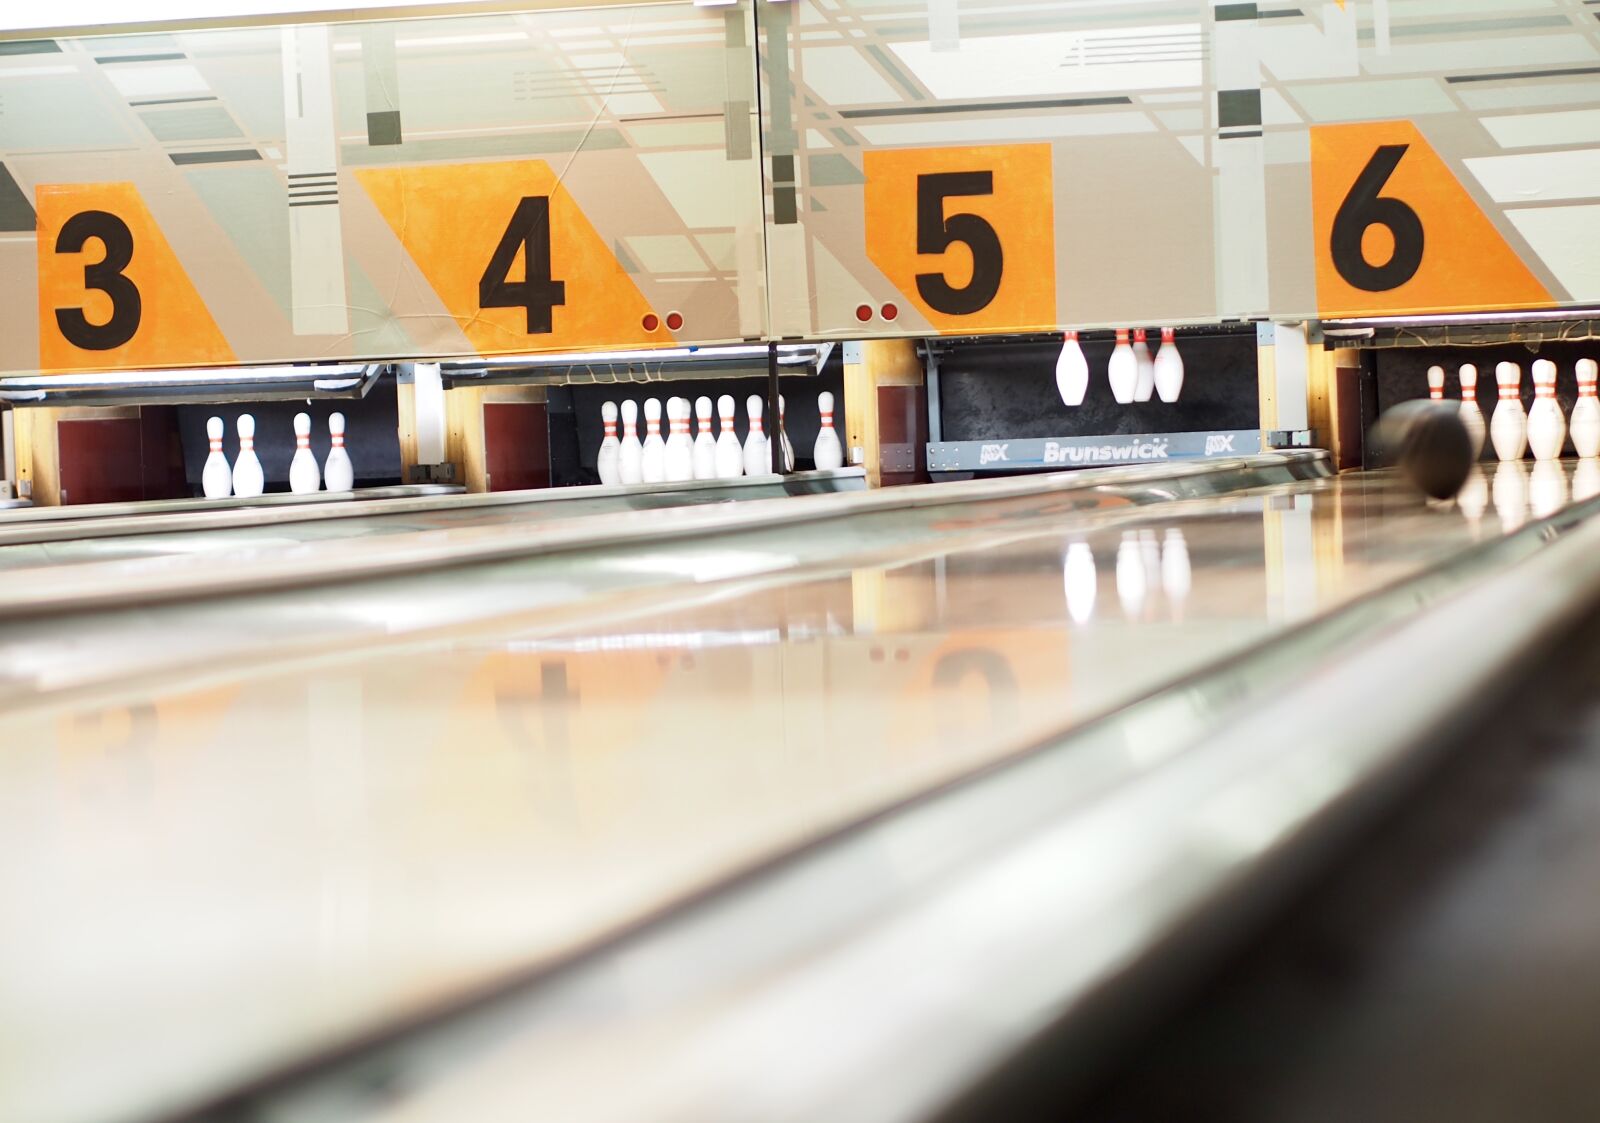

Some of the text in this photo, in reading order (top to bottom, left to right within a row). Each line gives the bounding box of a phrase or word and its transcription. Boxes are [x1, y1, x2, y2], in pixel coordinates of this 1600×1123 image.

[56, 211, 141, 350] 3
[479, 196, 565, 333] 4
[915, 170, 1003, 315] 5
[1329, 144, 1425, 292] 6
[1043, 438, 1168, 463] Brunswick
